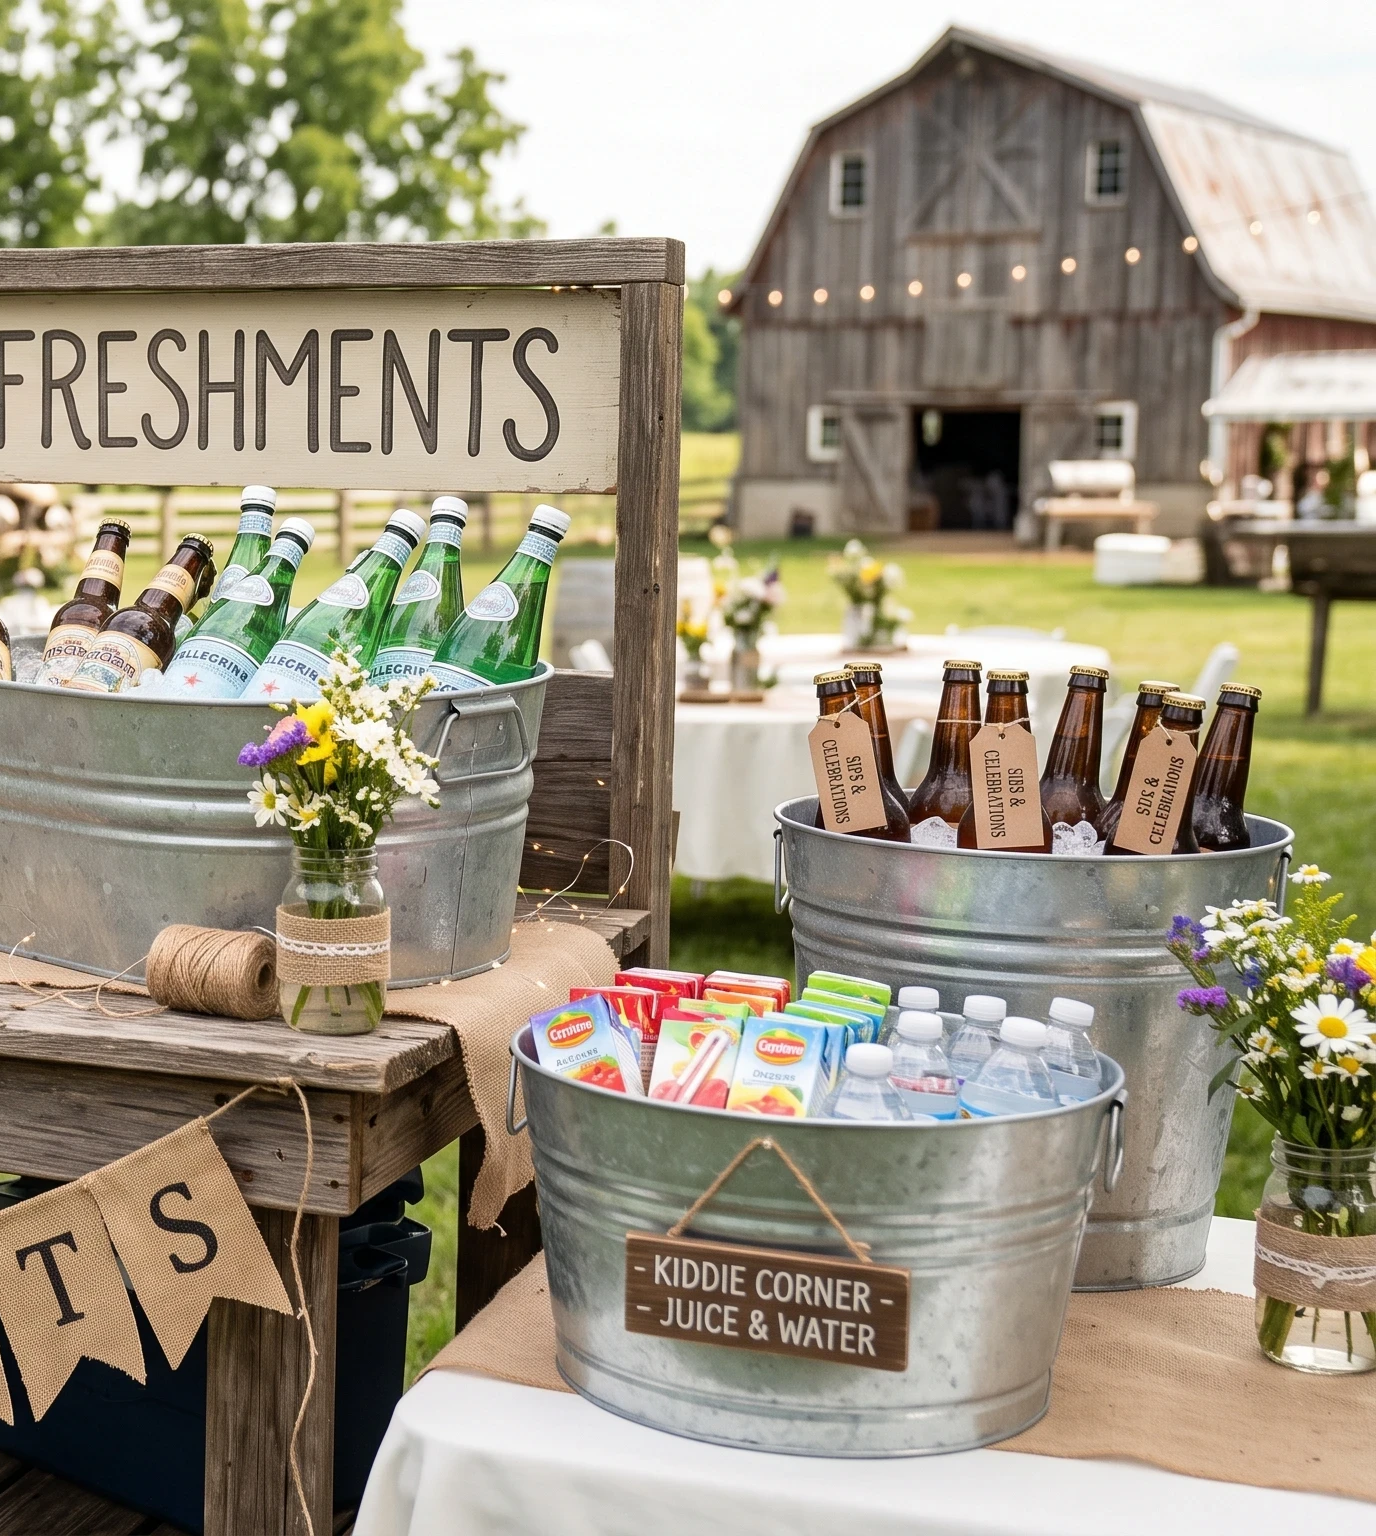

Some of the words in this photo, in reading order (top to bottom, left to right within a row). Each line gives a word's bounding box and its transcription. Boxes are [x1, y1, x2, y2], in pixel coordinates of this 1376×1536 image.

[822, 739, 851, 825] CELEBRATIONS
[850, 785, 867, 796] &
[984, 749, 1006, 838] CELEBRATIONS
[1009, 797, 1026, 808] &
[1143, 777, 1160, 788] &
[654, 1254, 747, 1297] KIDDIE
[755, 1268, 872, 1314] CORNER
[659, 1297, 739, 1337] JUICE
[748, 1308, 769, 1342] &
[777, 1311, 876, 1357] WATER
